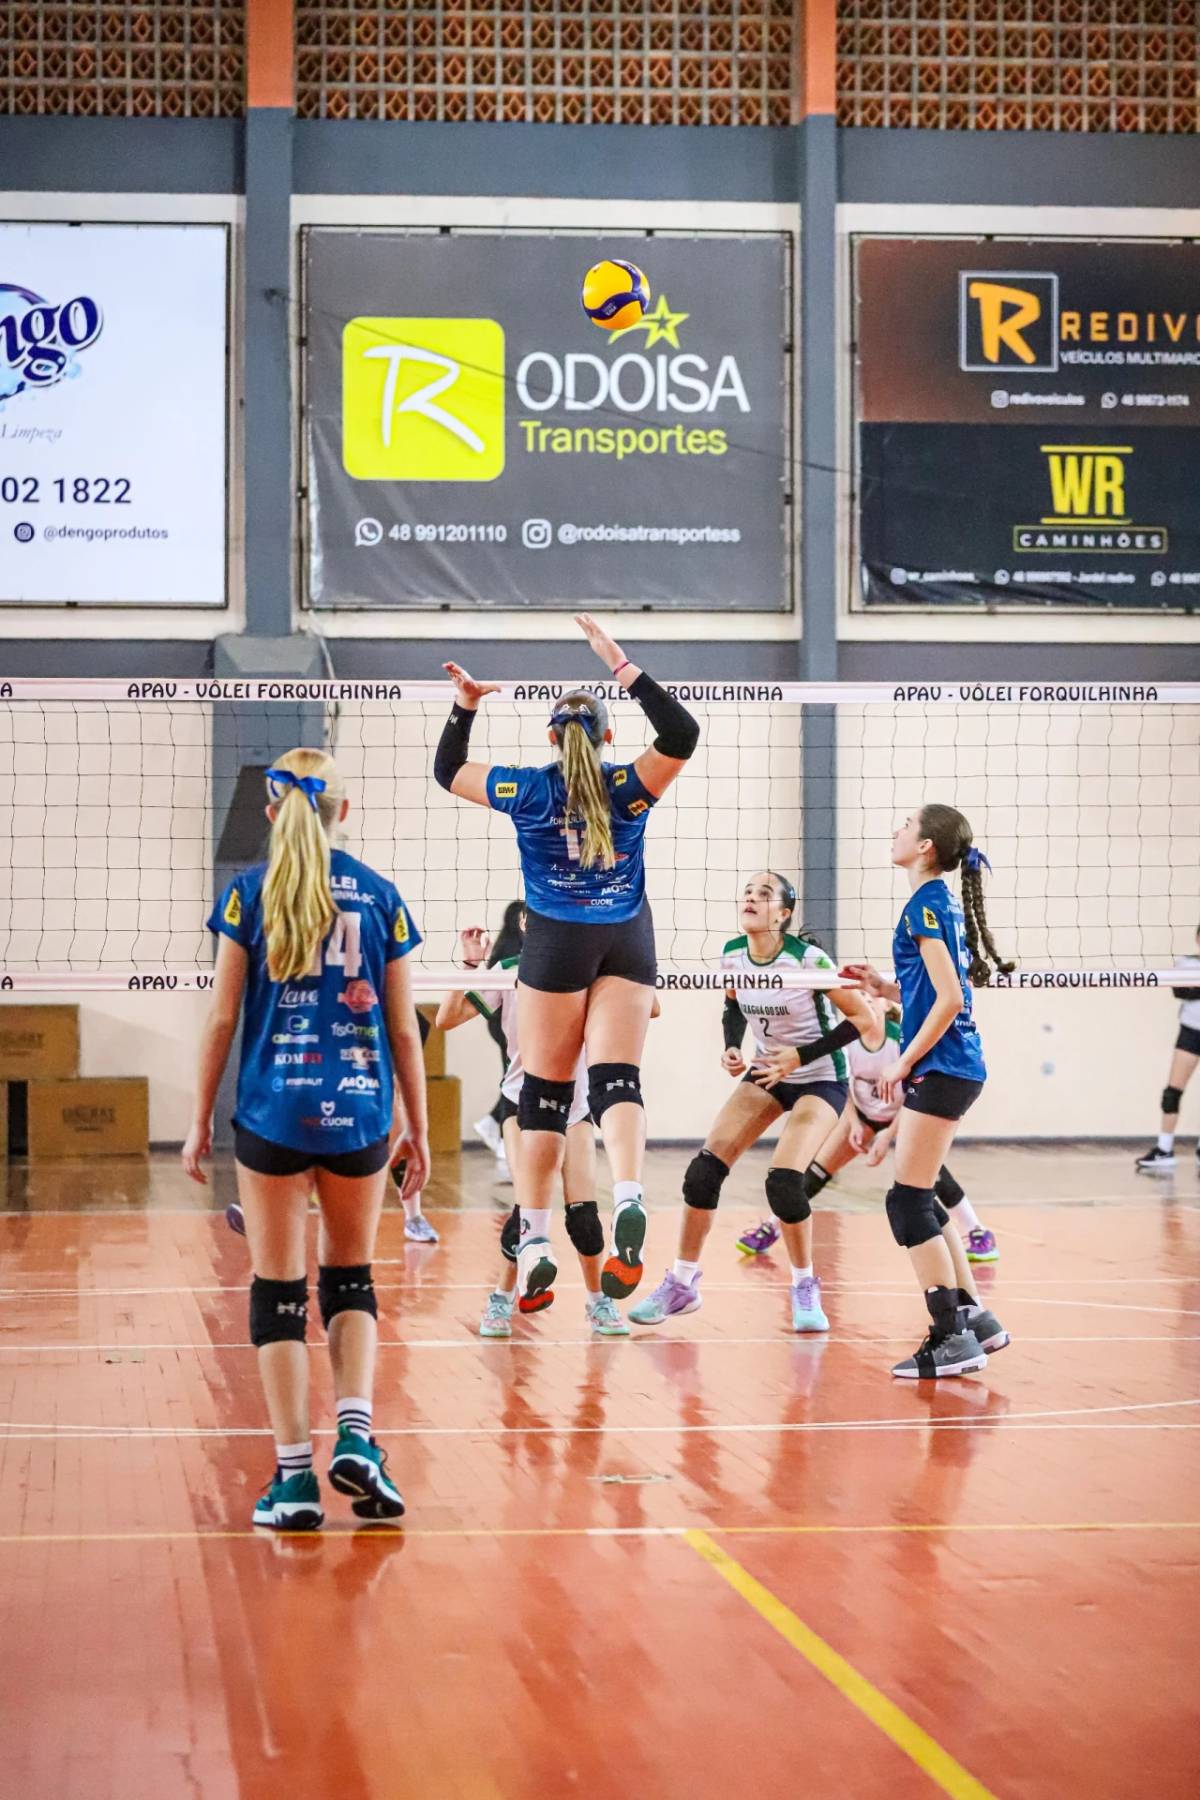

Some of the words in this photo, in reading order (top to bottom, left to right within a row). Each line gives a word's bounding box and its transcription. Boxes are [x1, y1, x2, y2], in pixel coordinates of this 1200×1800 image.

[1061, 311, 1200, 342] REDIV
[516, 352, 751, 413] ODOISA
[519, 421, 727, 459] Transportes
[1, 477, 39, 503] 02
[53, 478, 132, 504] 1822
[1048, 455, 1125, 516] WR
[44, 525, 168, 541] @dengoprodutos
[389, 524, 411, 541] 48
[415, 524, 507, 543] 991201110
[127, 684, 177, 698] APAV
[195, 680, 250, 699] VÔLEI
[258, 684, 401, 700] FORQUILHINHA
[514, 685, 563, 700] APAV
[668, 686, 783, 700] RQUILHINHA
[894, 687, 941, 701] APAV
[960, 683, 1012, 701] VÔLEI
[1020, 686, 1158, 701] FORQUILHINHA
[331, 875, 357, 890] LEI
[128, 976, 177, 990] APAV
[655, 974, 783, 989] ORQUILHINHA
[1020, 973, 1158, 988] FORQUILHINHA
[759, 1017, 773, 1037] 2
